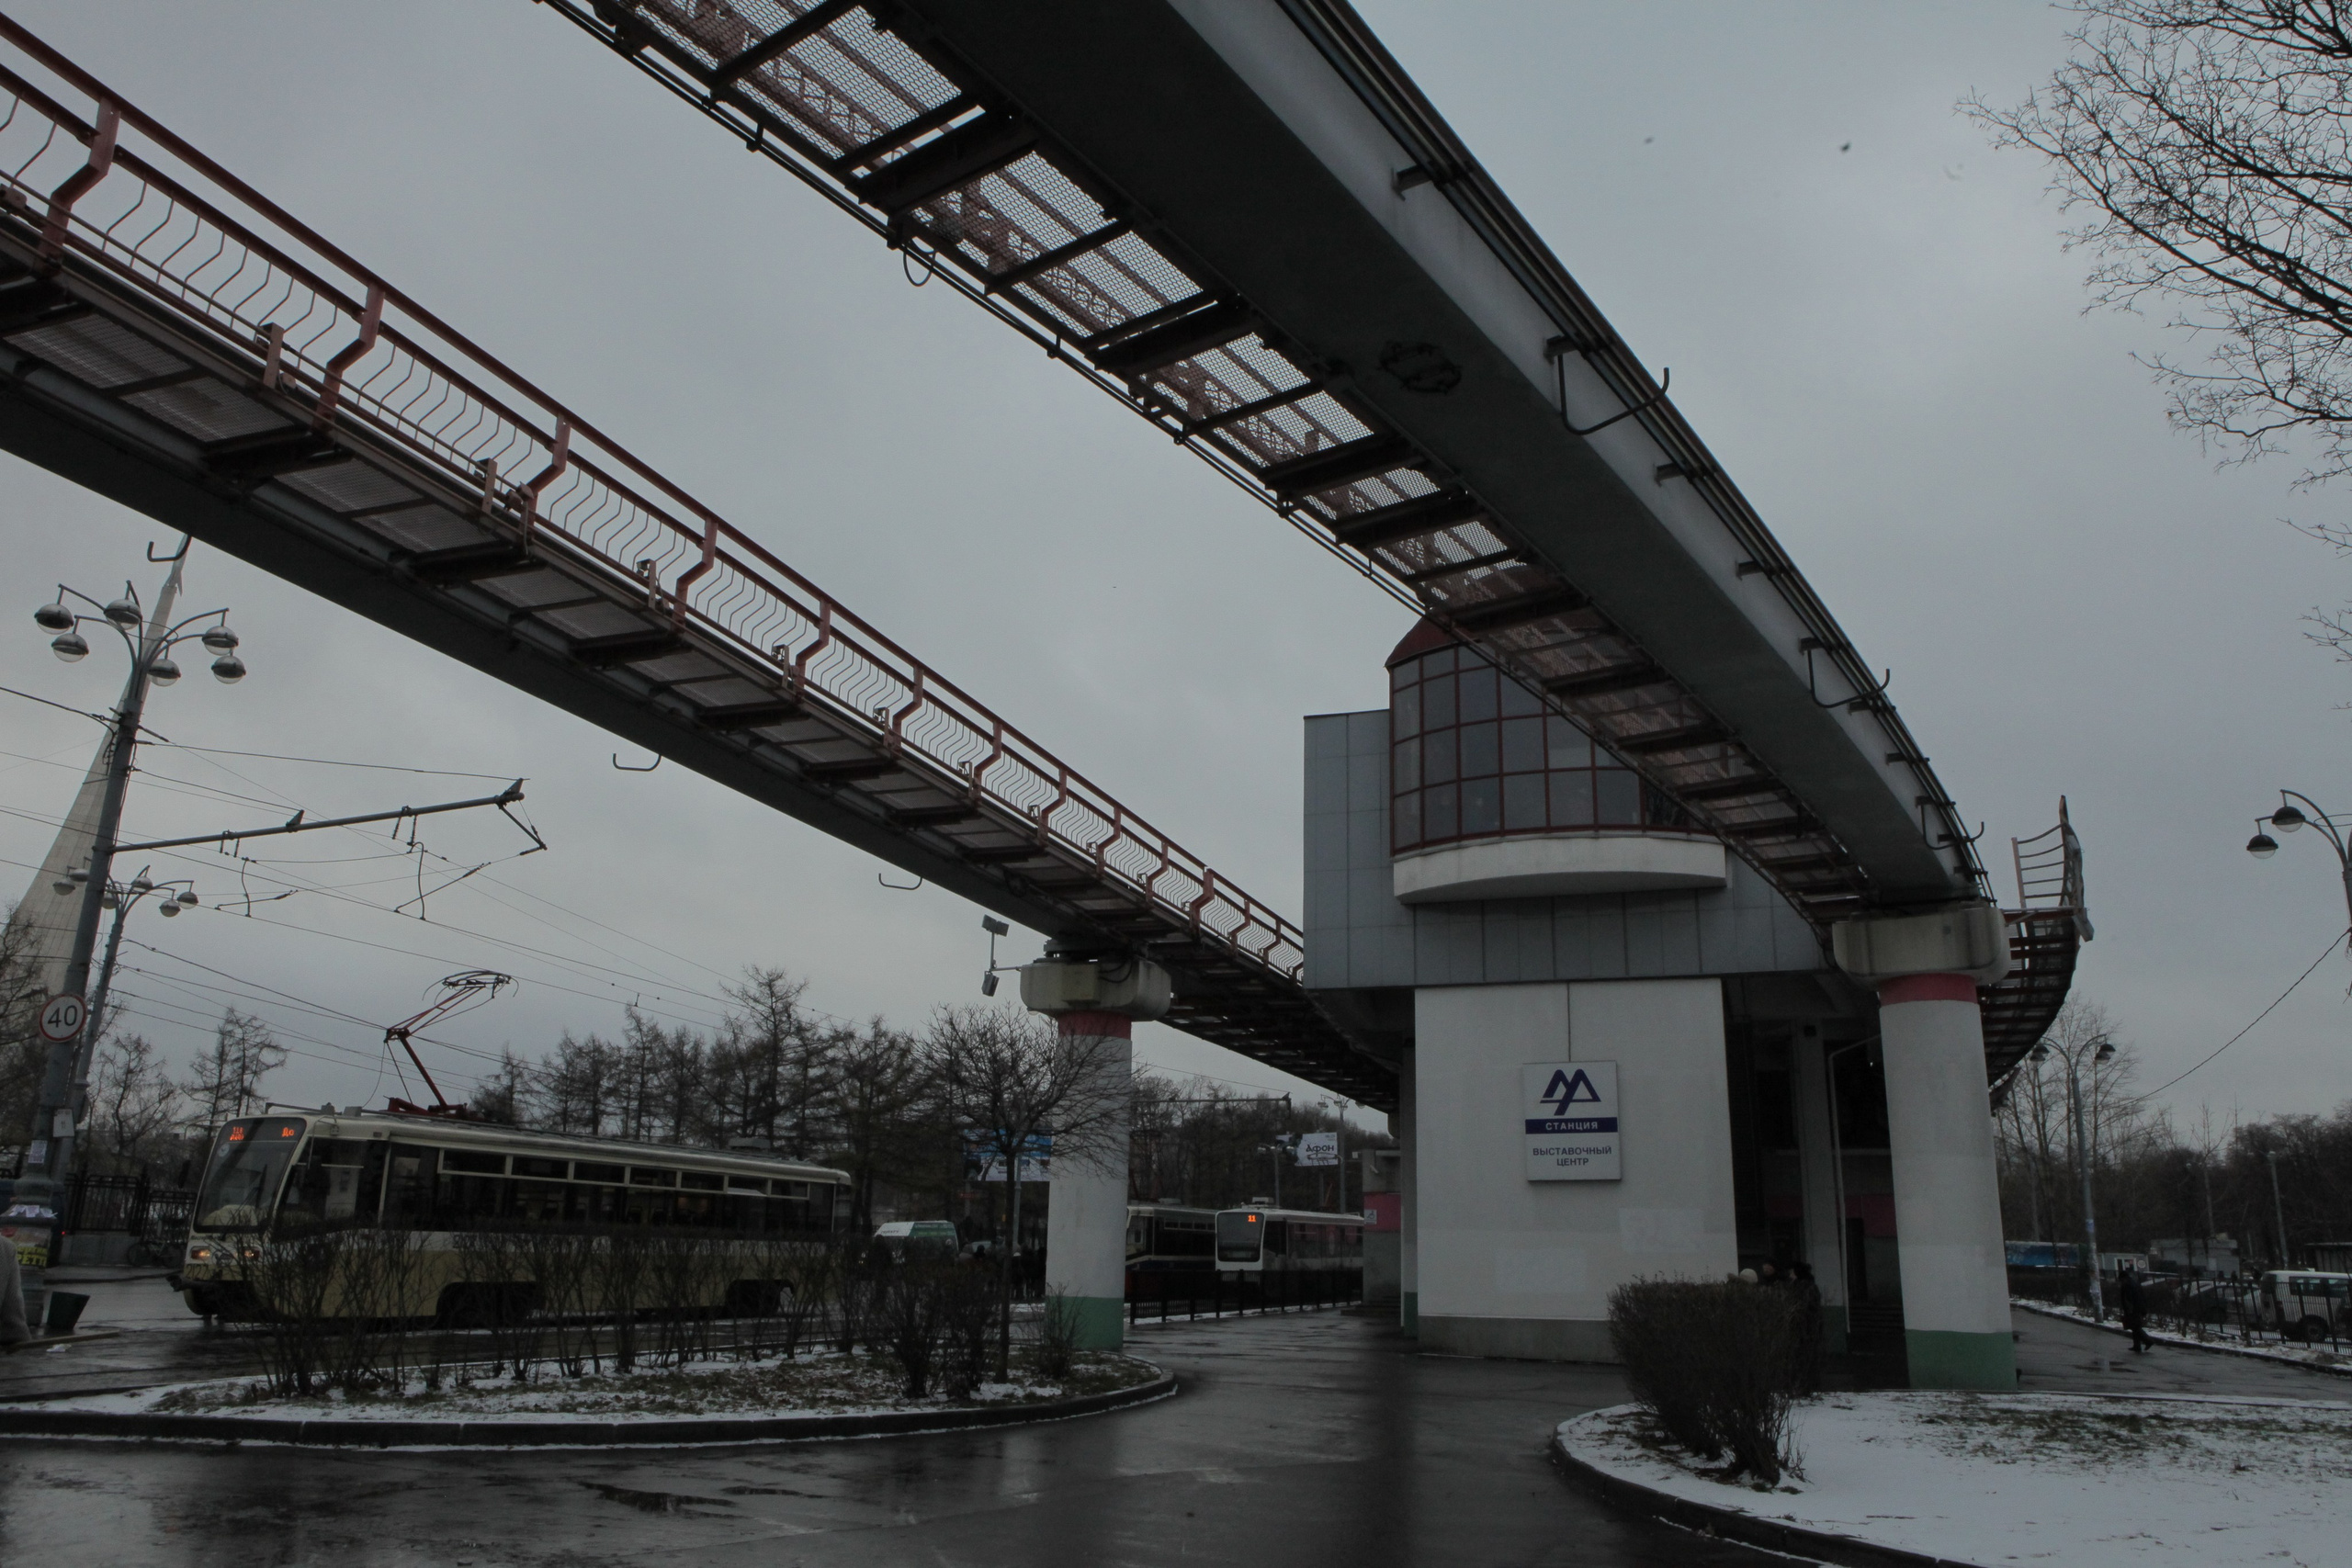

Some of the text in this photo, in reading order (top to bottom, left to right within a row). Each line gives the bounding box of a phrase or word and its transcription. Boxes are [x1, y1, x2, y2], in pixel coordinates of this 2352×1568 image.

[48, 1005, 77, 1028] 40
[1544, 1121, 1599, 1131] СТАНЦИЯ
[1532, 1145, 1612, 1156] ВЫСТАВОЧНЫЙ
[1556, 1157, 1589, 1167] ЦЕНТР
[1248, 1214, 1257, 1223] 11
